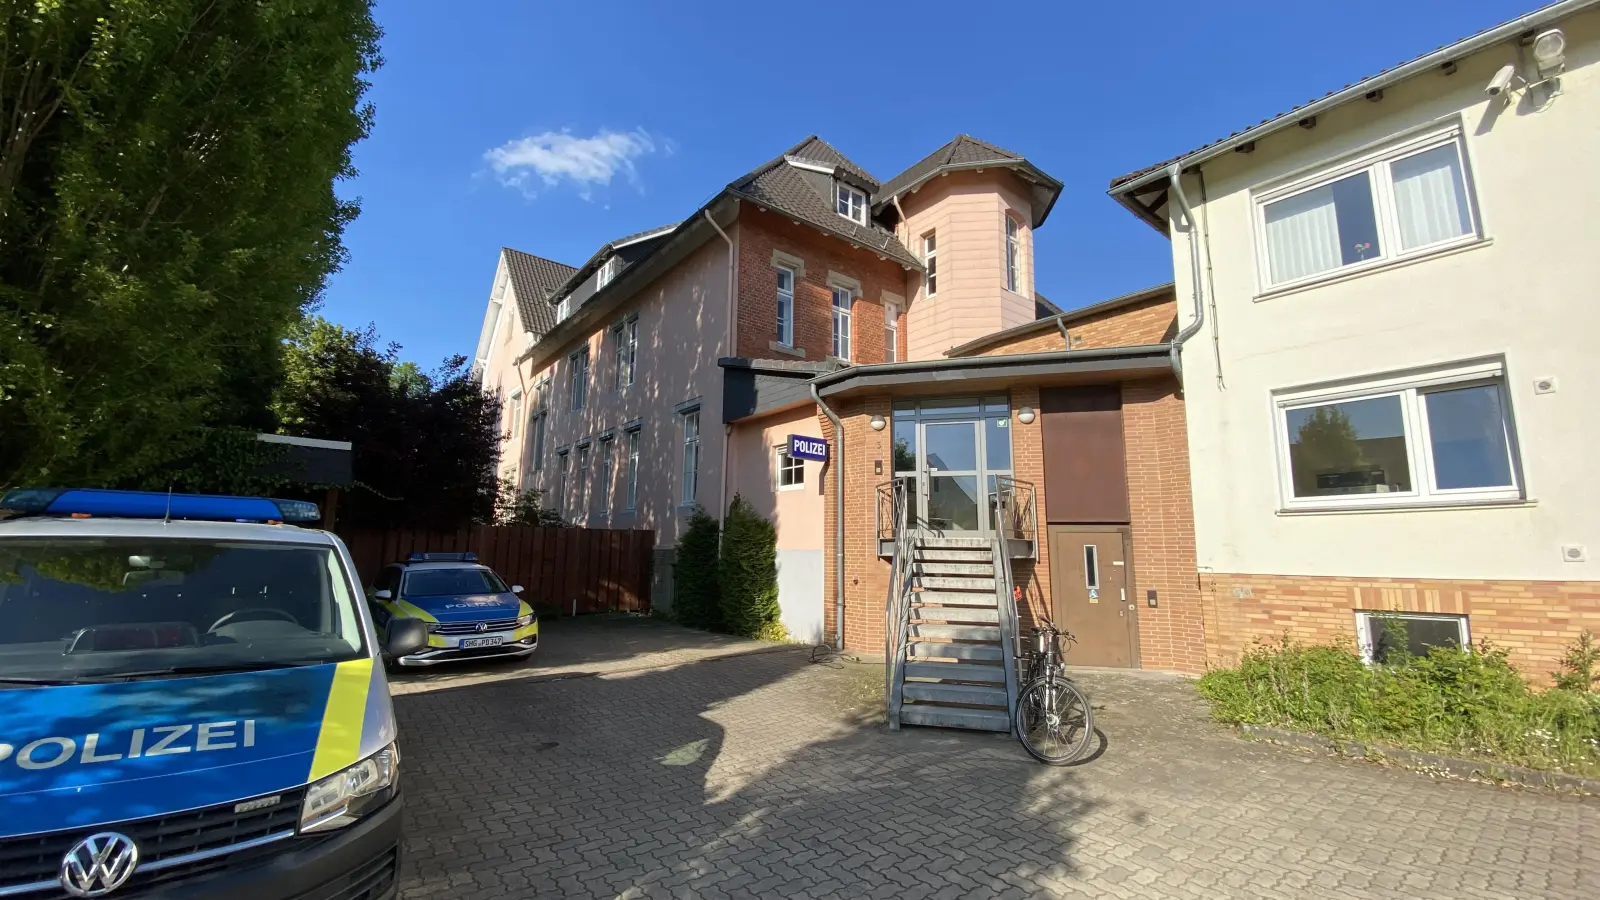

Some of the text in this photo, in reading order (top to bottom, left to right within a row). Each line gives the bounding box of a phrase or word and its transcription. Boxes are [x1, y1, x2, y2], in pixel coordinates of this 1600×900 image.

[794, 439, 826, 456] POLIZEI
[876, 441, 882, 450] 3
[0, 719, 256, 770] OLIZEI
